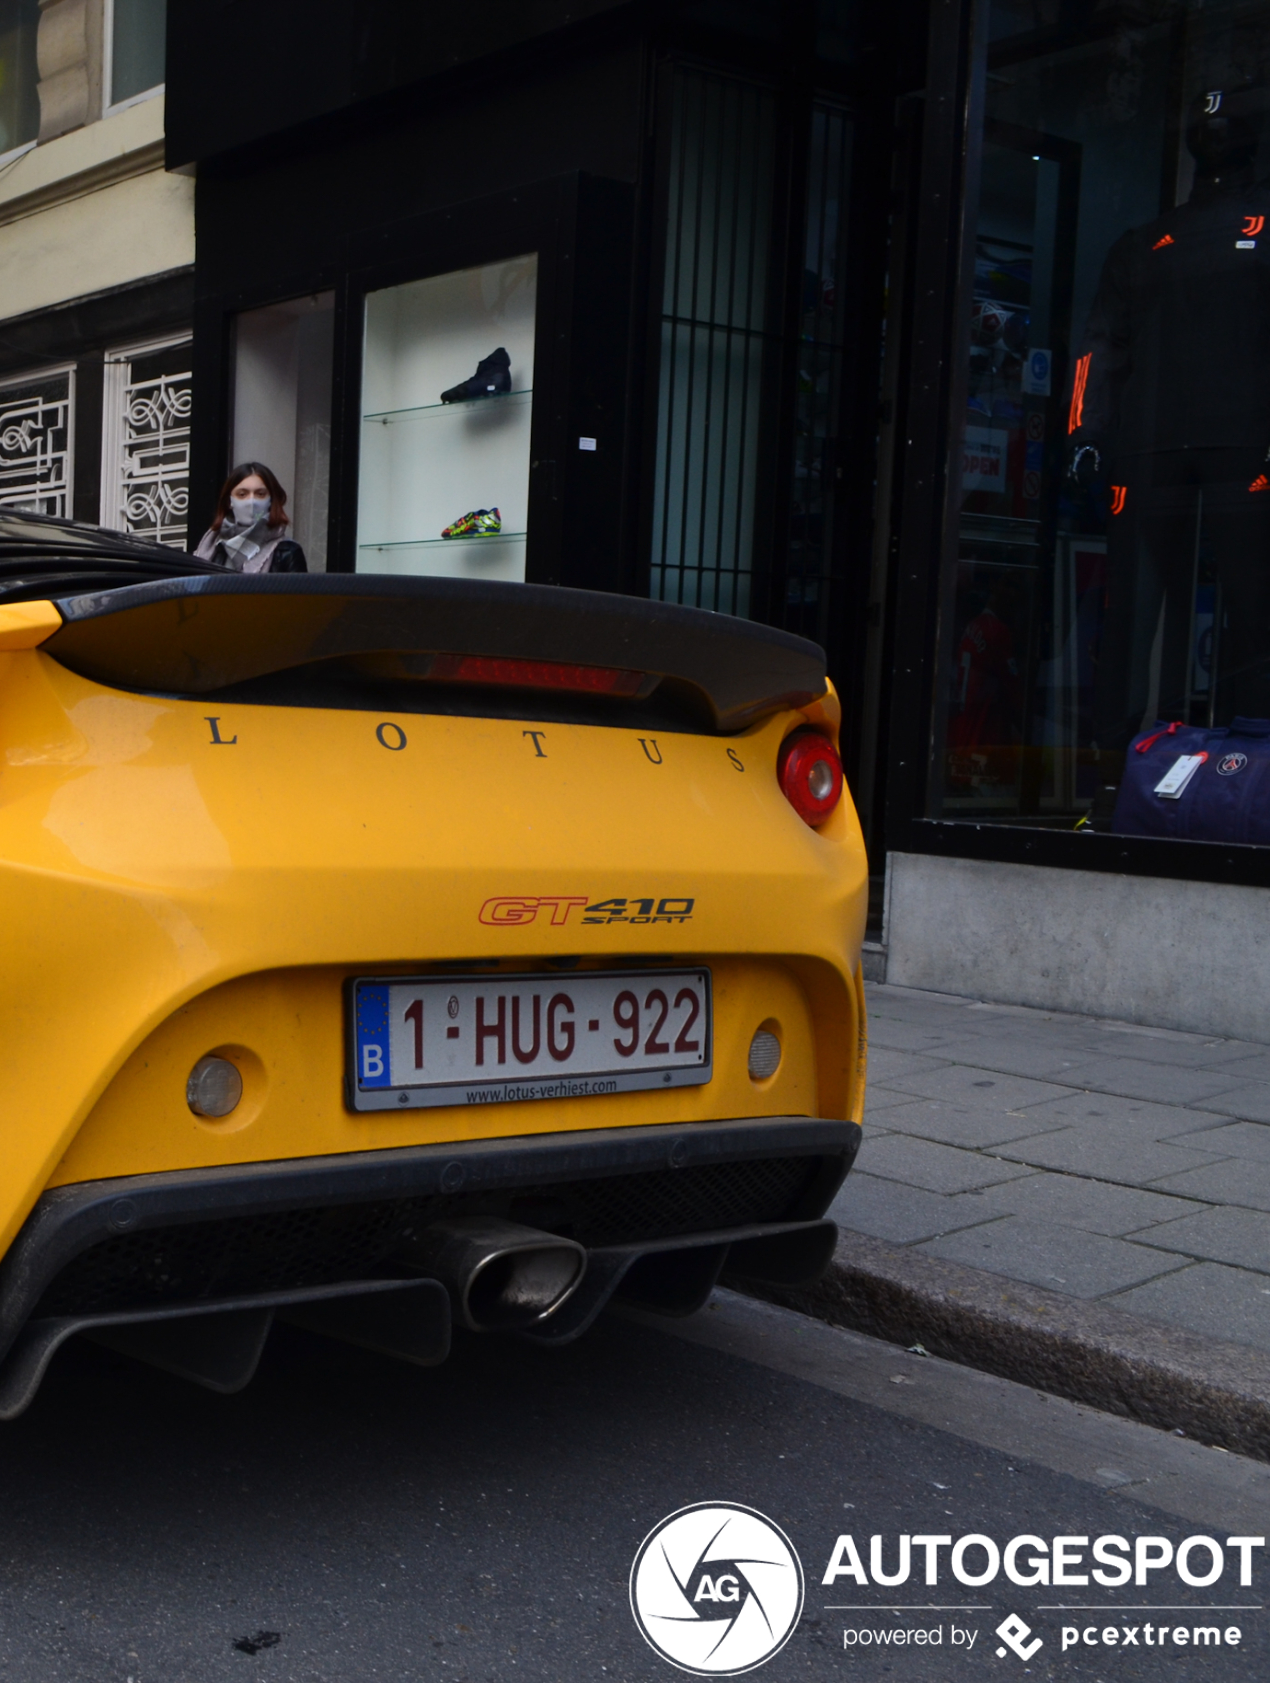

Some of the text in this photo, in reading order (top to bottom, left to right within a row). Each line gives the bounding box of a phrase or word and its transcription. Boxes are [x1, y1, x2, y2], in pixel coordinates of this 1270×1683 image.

[204, 716, 745, 772] LOTUS
[581, 916, 694, 925] SPORT
[362, 1044, 384, 1078] B
[466, 1078, 618, 1104] www.lotus-verhiest.com
